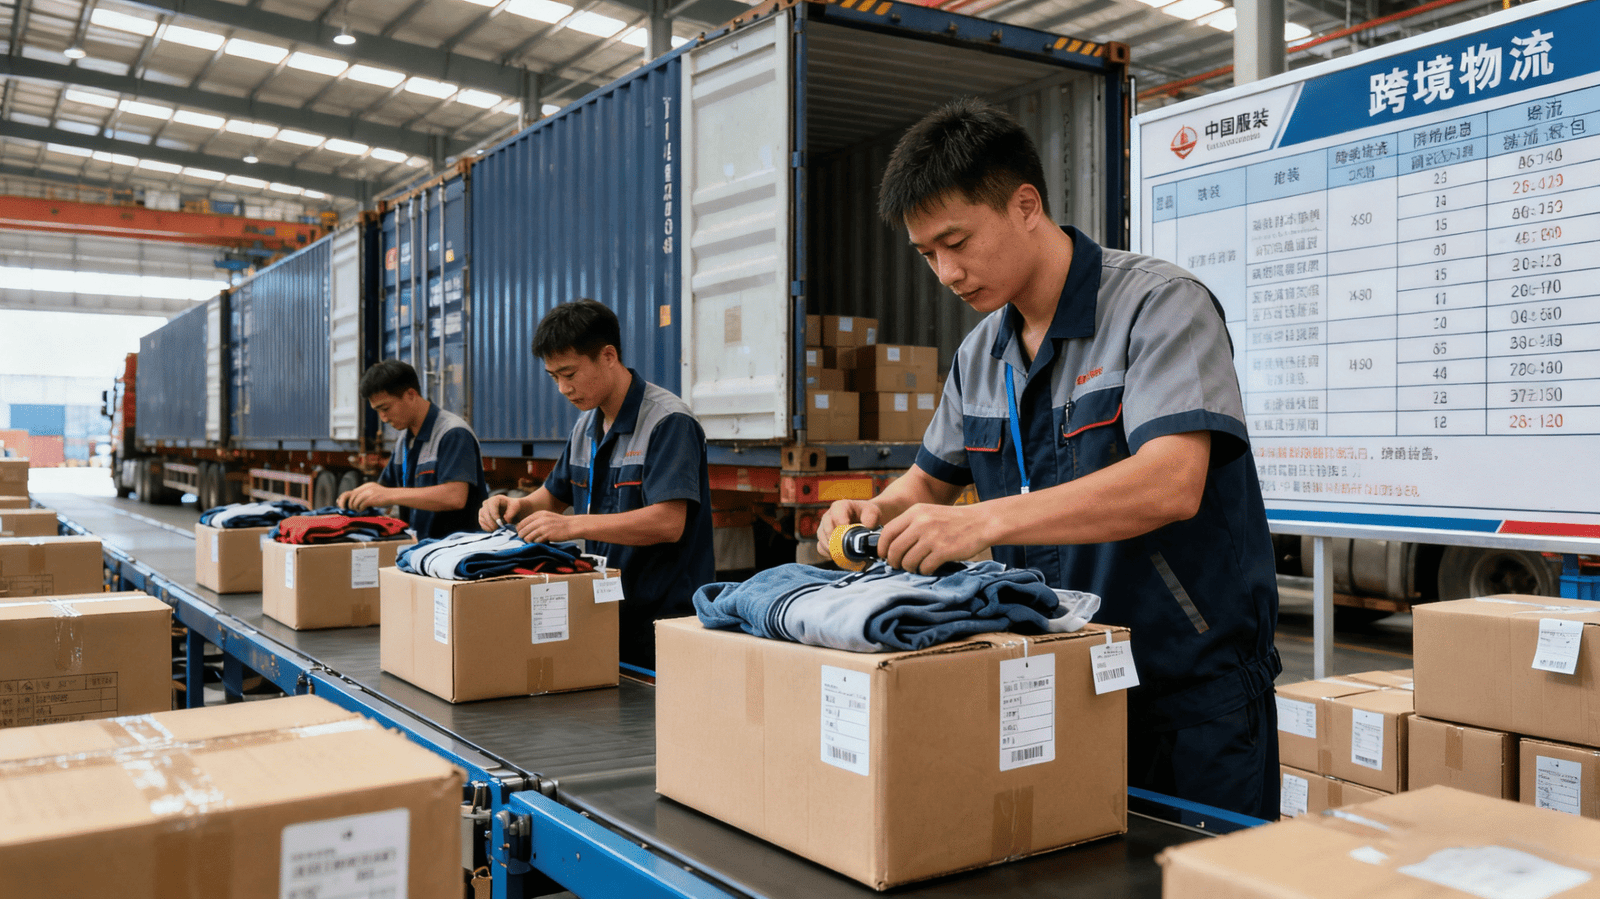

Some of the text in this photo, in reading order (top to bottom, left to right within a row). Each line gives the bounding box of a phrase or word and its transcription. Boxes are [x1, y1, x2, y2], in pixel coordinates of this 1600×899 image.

[1368, 29, 1556, 118] 跨境物流
[1204, 108, 1270, 140] 中国服装
